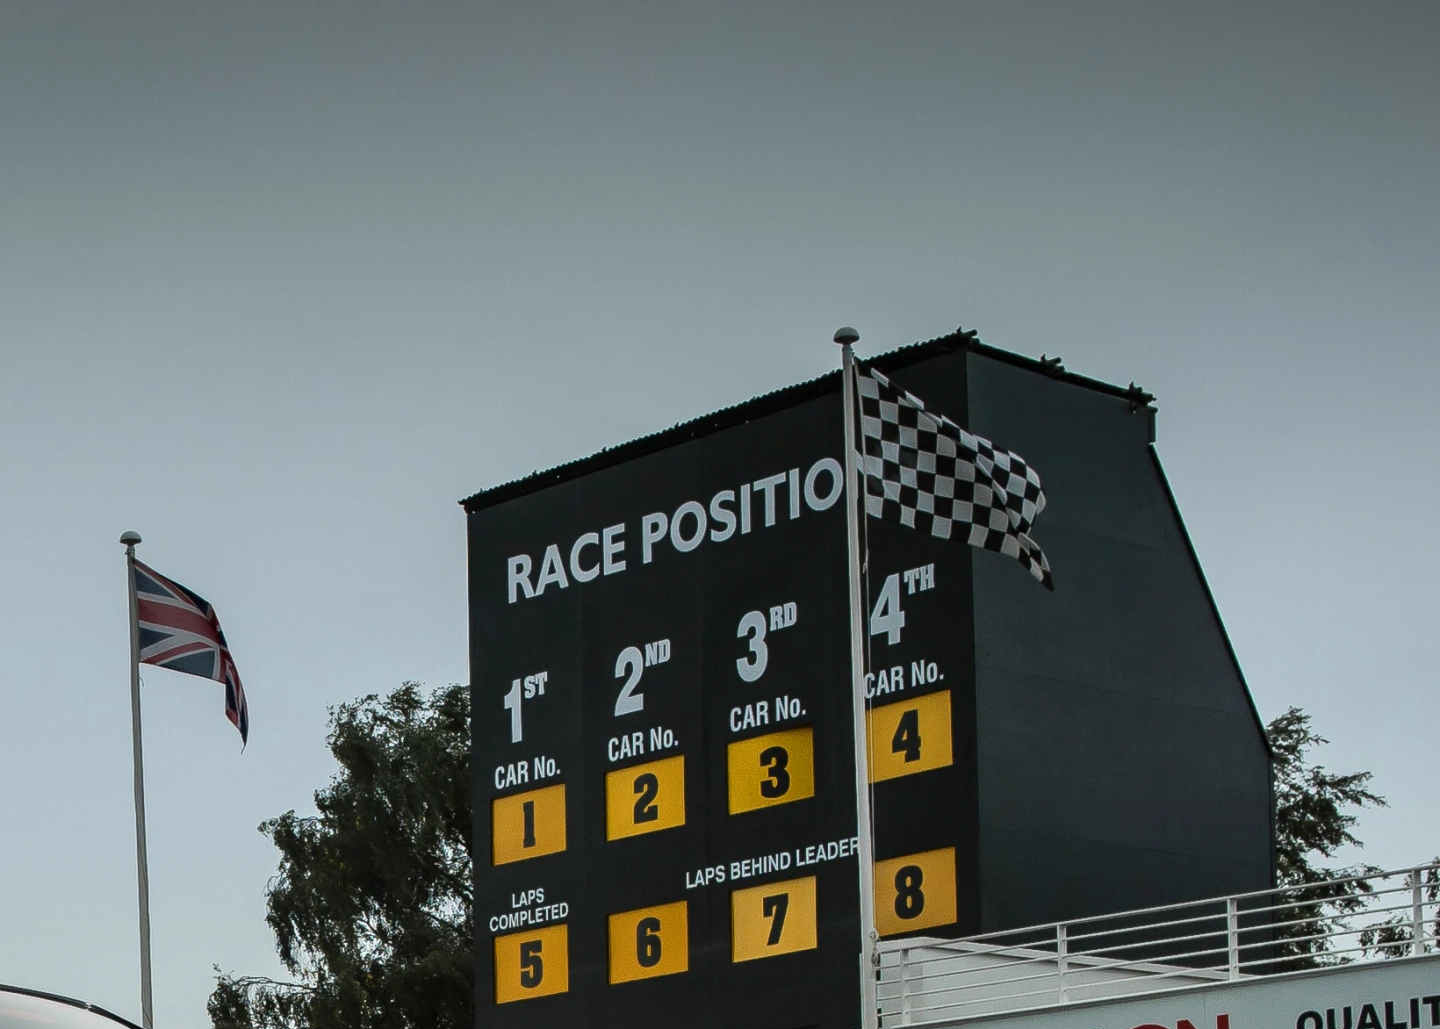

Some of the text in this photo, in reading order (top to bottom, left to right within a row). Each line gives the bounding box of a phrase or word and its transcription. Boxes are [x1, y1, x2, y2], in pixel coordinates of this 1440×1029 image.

[507, 523, 626, 604] RACE
[870, 563, 935, 646] 4TH
[736, 602, 798, 682] 3RD
[615, 637, 671, 717] 2ND
[863, 659, 945, 699] CAR No.
[504, 671, 548, 743] 1ST
[730, 695, 807, 733] CAR No.
[608, 726, 679, 762] CAR No.
[891, 708, 922, 764] 4
[494, 755, 561, 790] CAR No.
[633, 772, 659, 825] 2
[760, 745, 791, 799] 3
[522, 800, 536, 849] 1
[685, 836, 860, 889] LAPS BEHIND LEADER
[489, 902, 569, 932] COMPLETED
[511, 888, 545, 909] LAPS
[763, 892, 789, 946] 7
[894, 865, 925, 921] 8
[520, 939, 543, 989] 5
[635, 916, 662, 968] 6
